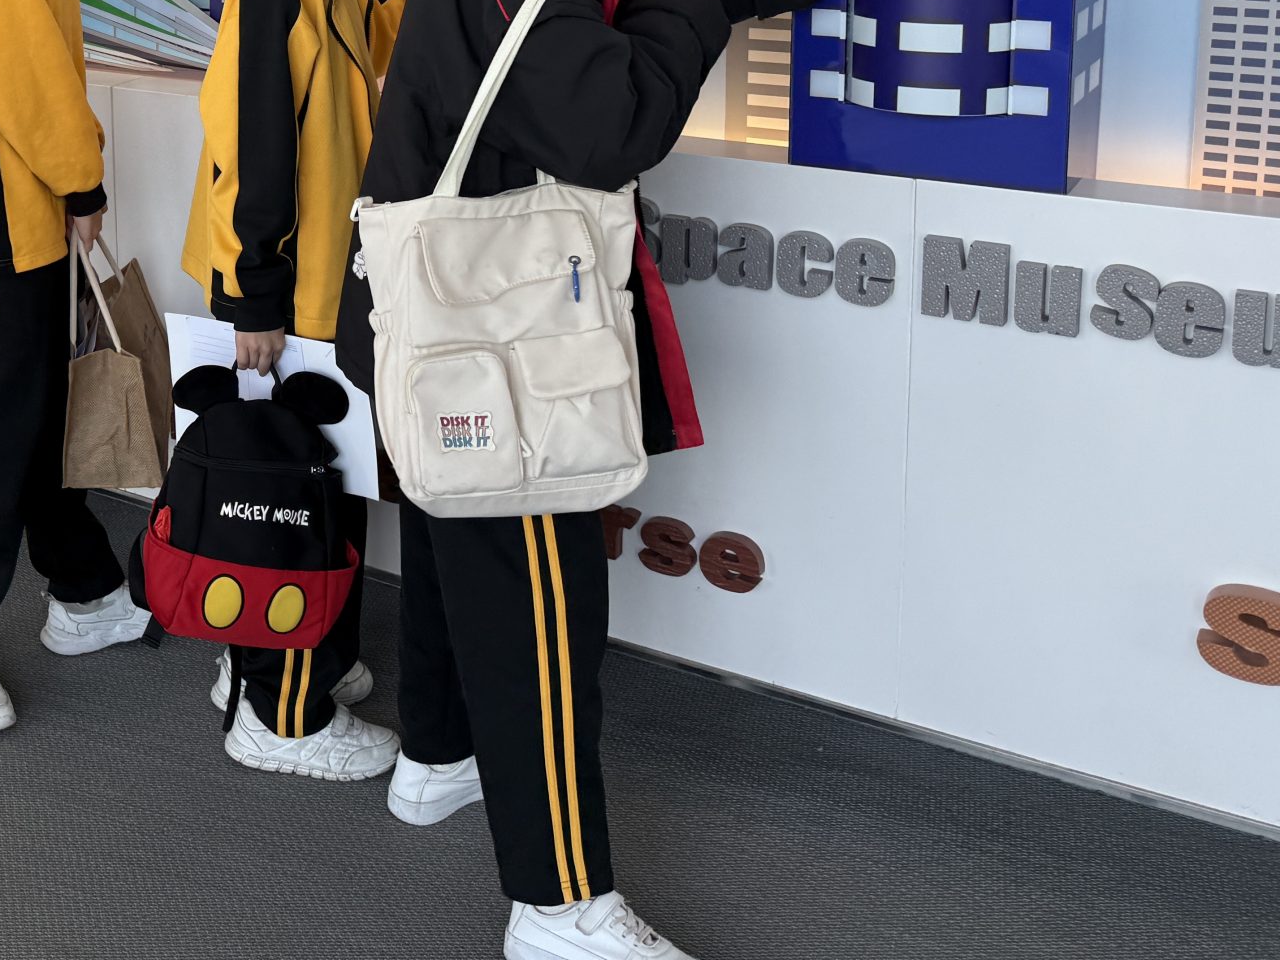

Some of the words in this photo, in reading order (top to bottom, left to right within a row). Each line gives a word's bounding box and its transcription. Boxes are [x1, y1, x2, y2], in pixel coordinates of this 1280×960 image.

[440, 416, 470, 427] DISK
[474, 415, 488, 426] IT
[441, 426, 472, 437] DISK
[476, 426, 489, 437] IT
[442, 437, 473, 448] DISK
[476, 436, 490, 447] IT
[220, 501, 269, 521] MICKEY
[272, 508, 310, 526] MOUSE
[599, 504, 766, 593] rse
